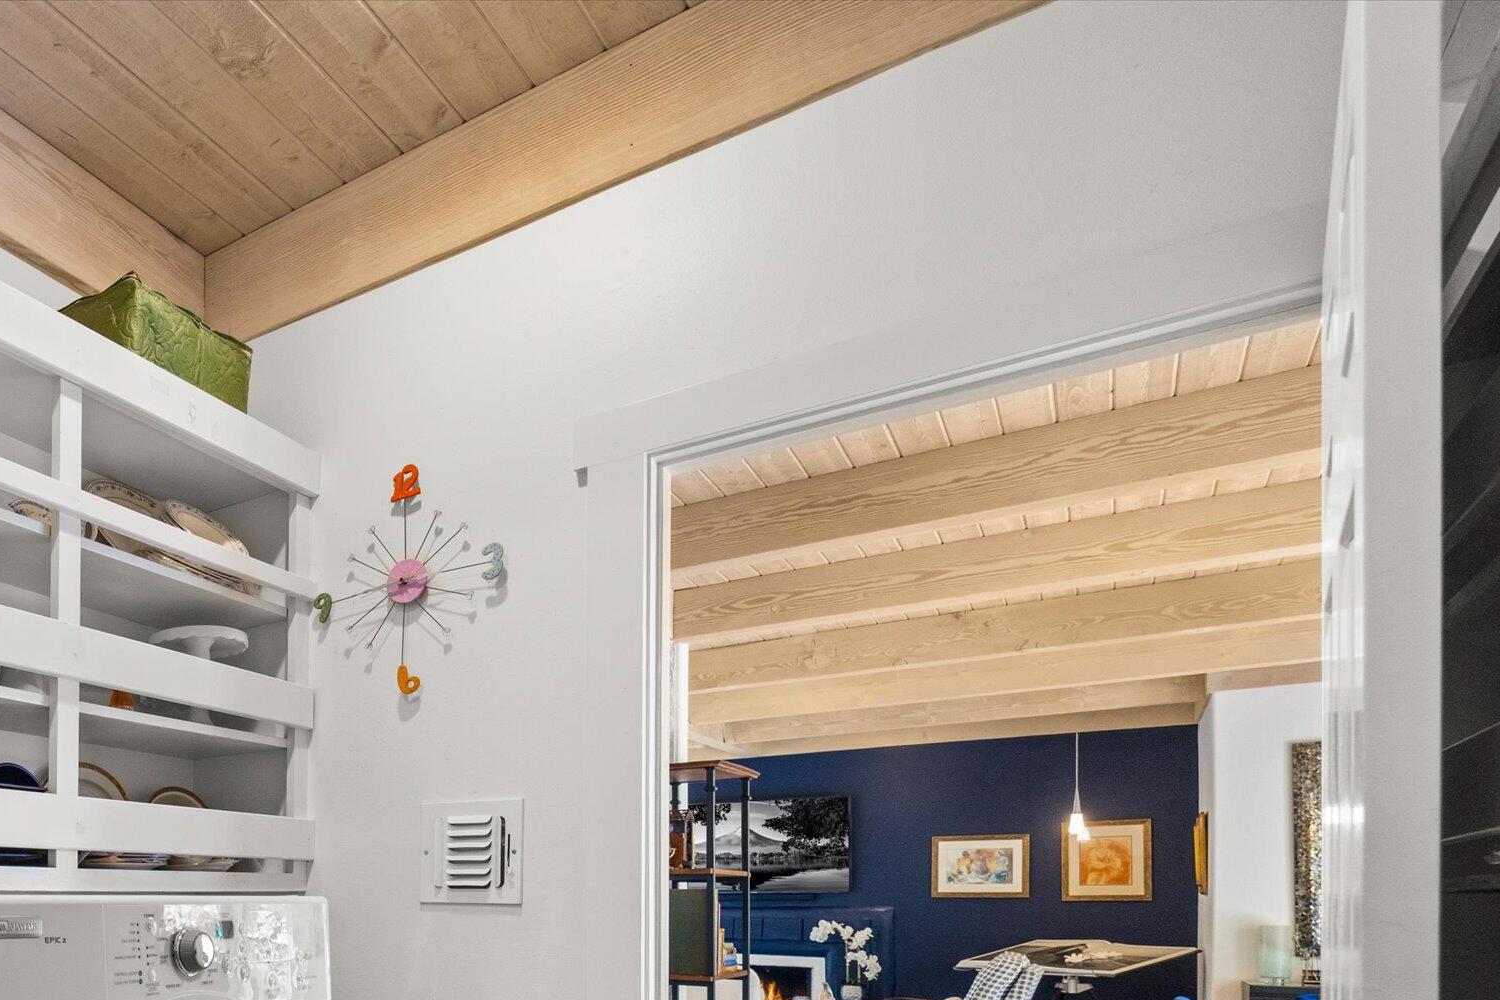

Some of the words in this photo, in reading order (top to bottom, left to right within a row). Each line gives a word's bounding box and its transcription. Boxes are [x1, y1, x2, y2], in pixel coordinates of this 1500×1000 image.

[390, 463, 421, 503] 12
[481, 542, 504, 581] 3
[313, 592, 333, 624] 9
[396, 664, 421, 695] 6
[44, 936, 61, 944] EPIC
